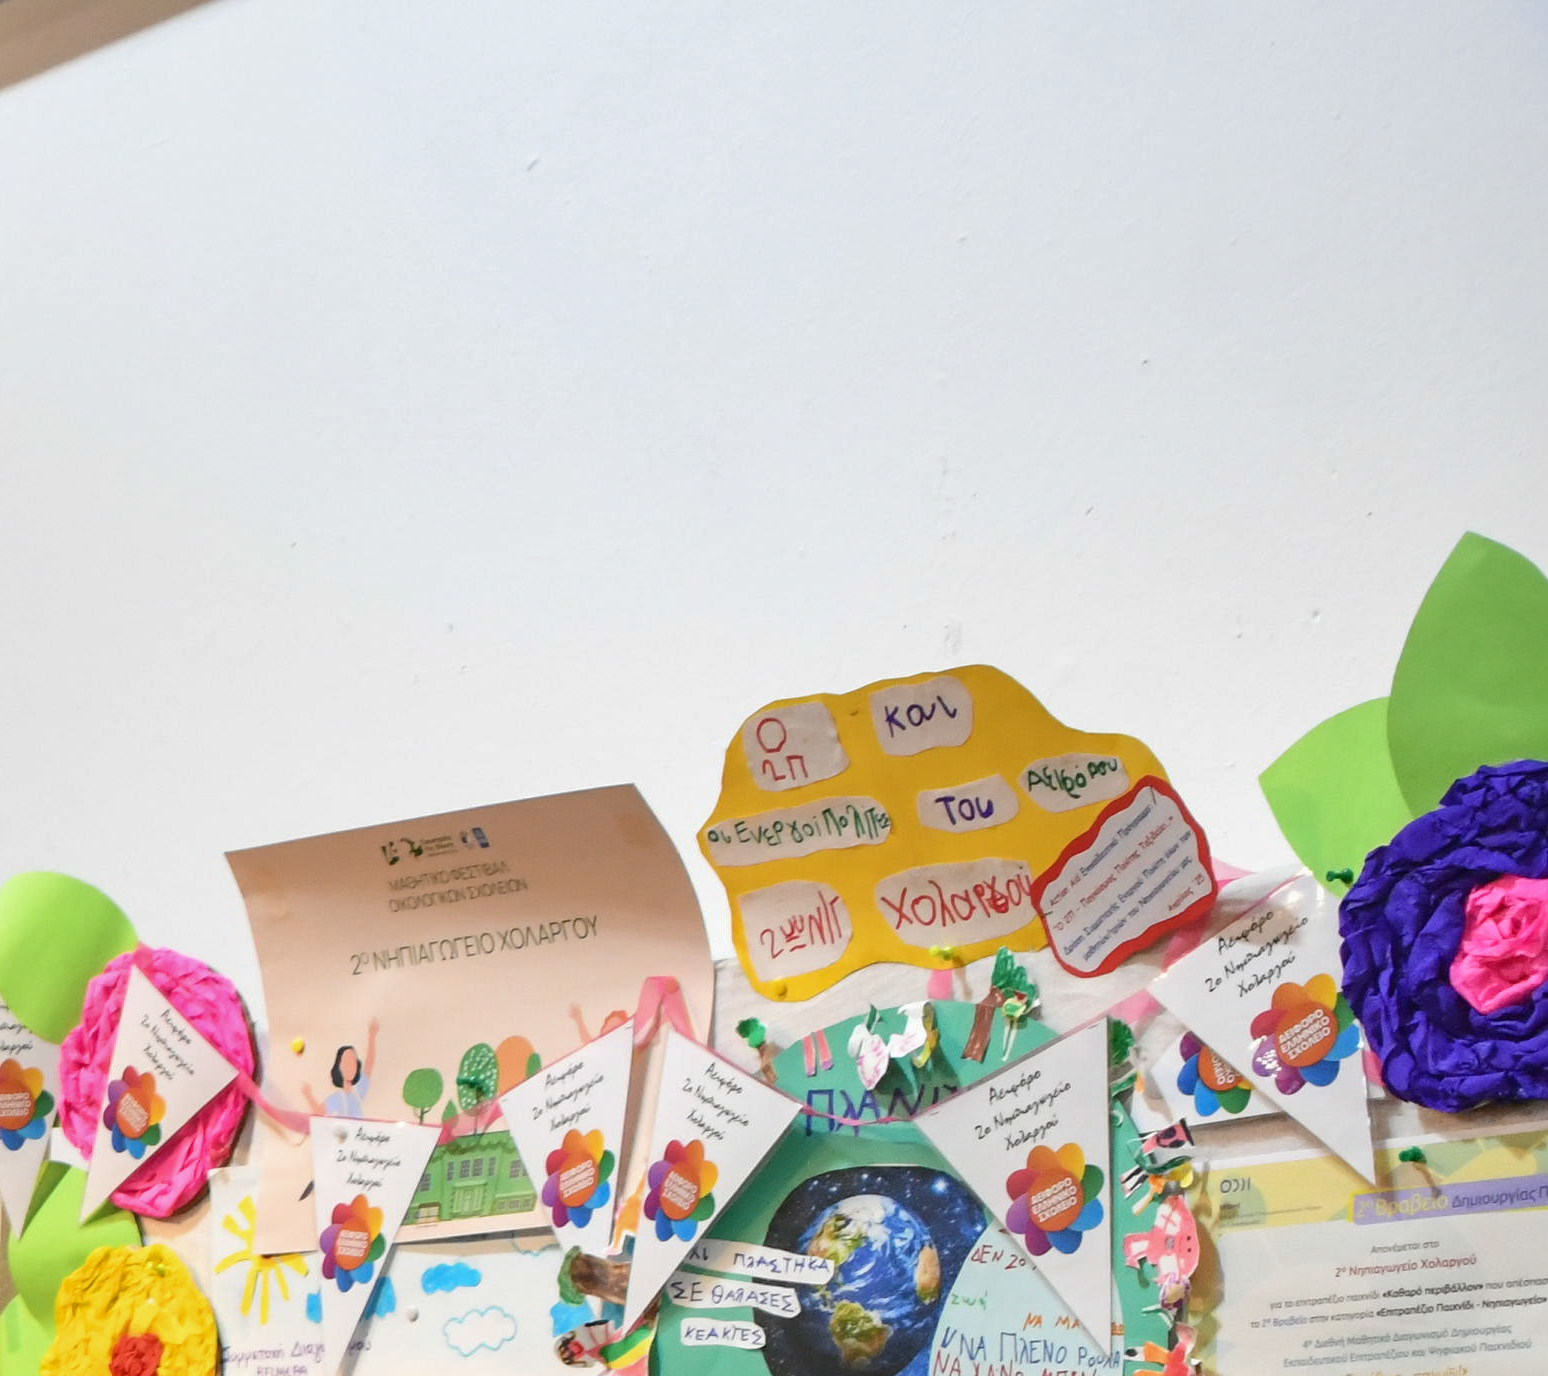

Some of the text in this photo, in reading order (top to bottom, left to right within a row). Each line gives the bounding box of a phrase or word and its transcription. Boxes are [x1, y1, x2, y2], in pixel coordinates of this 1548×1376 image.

[373, 916, 599, 972] ΝΗΠΙΑΓΩΓΕΙΟ ΧΟΛΑΡΓΟΥ
[1278, 1008, 1325, 1042] ΑΕΙΦΟΡΟ
[1280, 1017, 1331, 1055] ΕΛΛΗΝΙΚΟ
[1289, 1027, 1331, 1069] ΣΧΟΛΕΙΟ
[1030, 1177, 1072, 1205] ΑΕΙΦΟΡΟ
[1031, 1186, 1077, 1215] ΕΛΛΗΝΙΚΟ
[1039, 1197, 1077, 1222] ΣΧΟΛΕΙΟ
[1349, 1254, 1477, 1277] Νηπιαγωγείο Χολαργού
